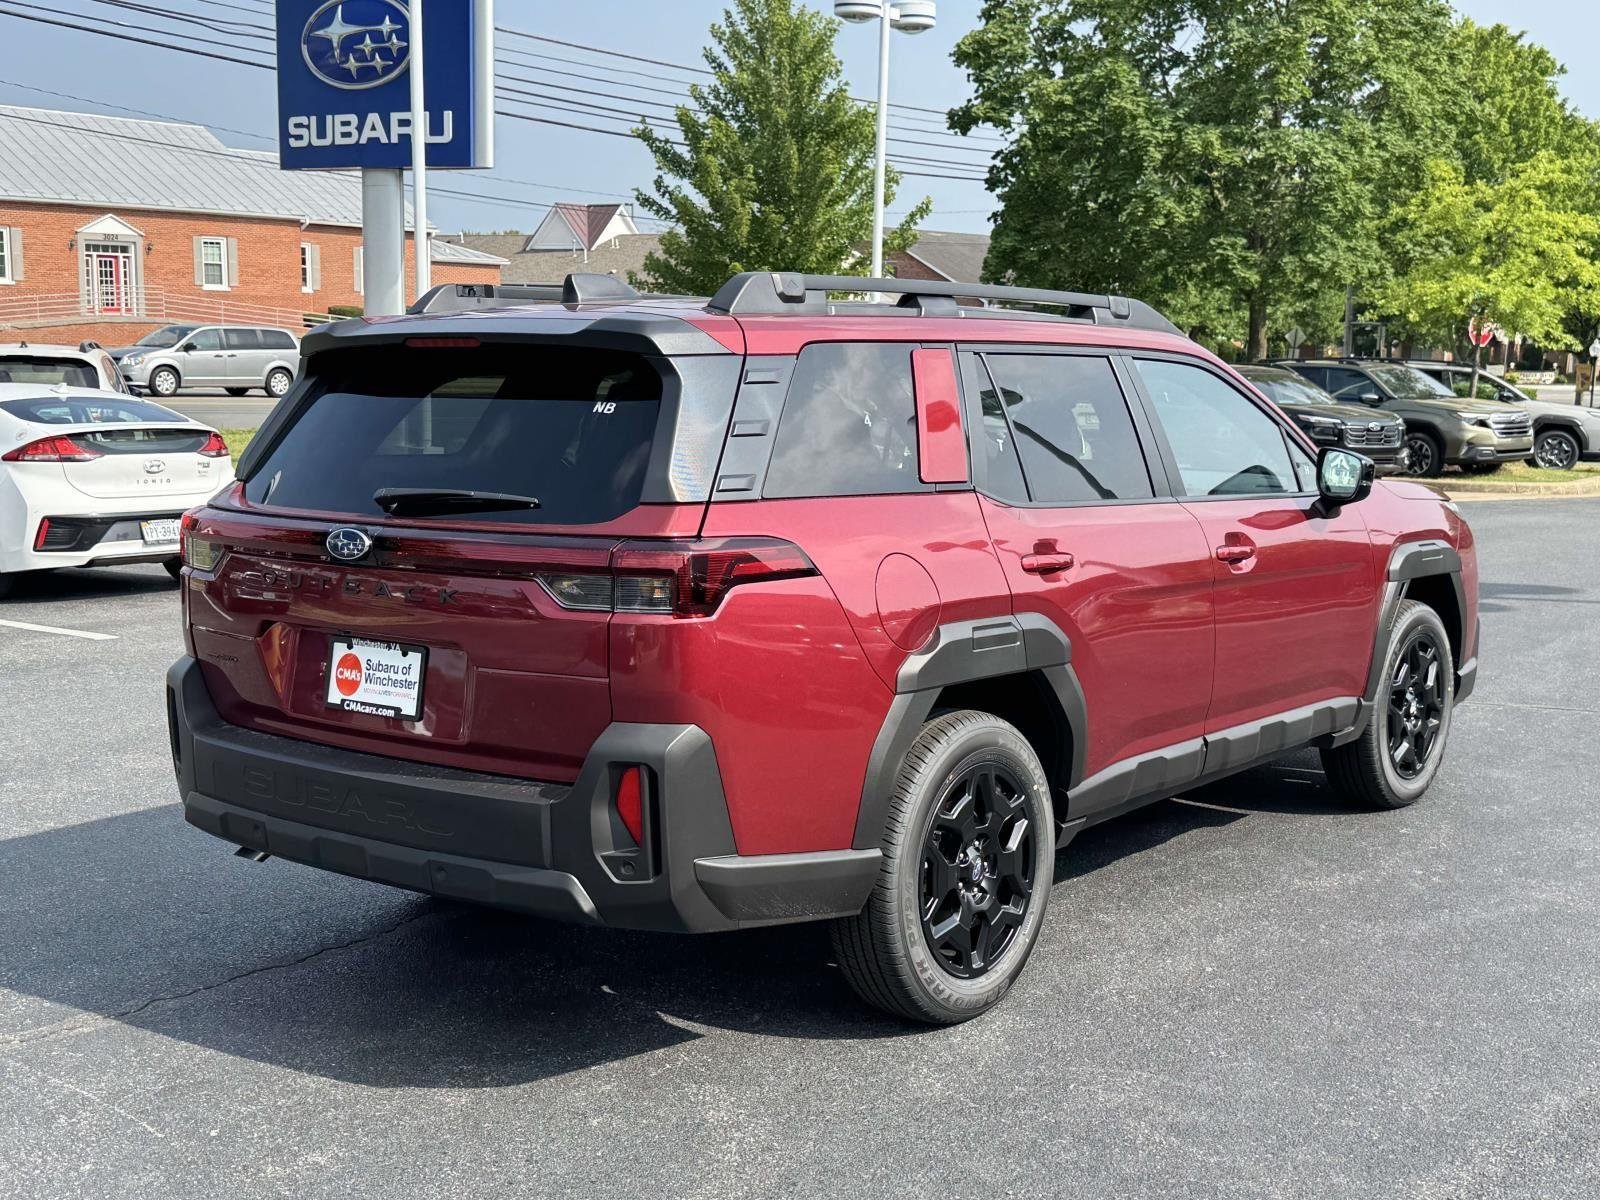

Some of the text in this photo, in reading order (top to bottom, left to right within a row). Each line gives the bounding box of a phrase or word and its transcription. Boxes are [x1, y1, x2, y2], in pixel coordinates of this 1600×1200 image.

[288, 110, 453, 148] SUBARU
[592, 401, 617, 414] NB
[262, 569, 458, 604] OUTBACK
[337, 668, 361, 680] CMA's
[365, 659, 412, 675] Subaru of
[364, 672, 417, 690] Winchester
[343, 701, 395, 717] CMAcars.com
